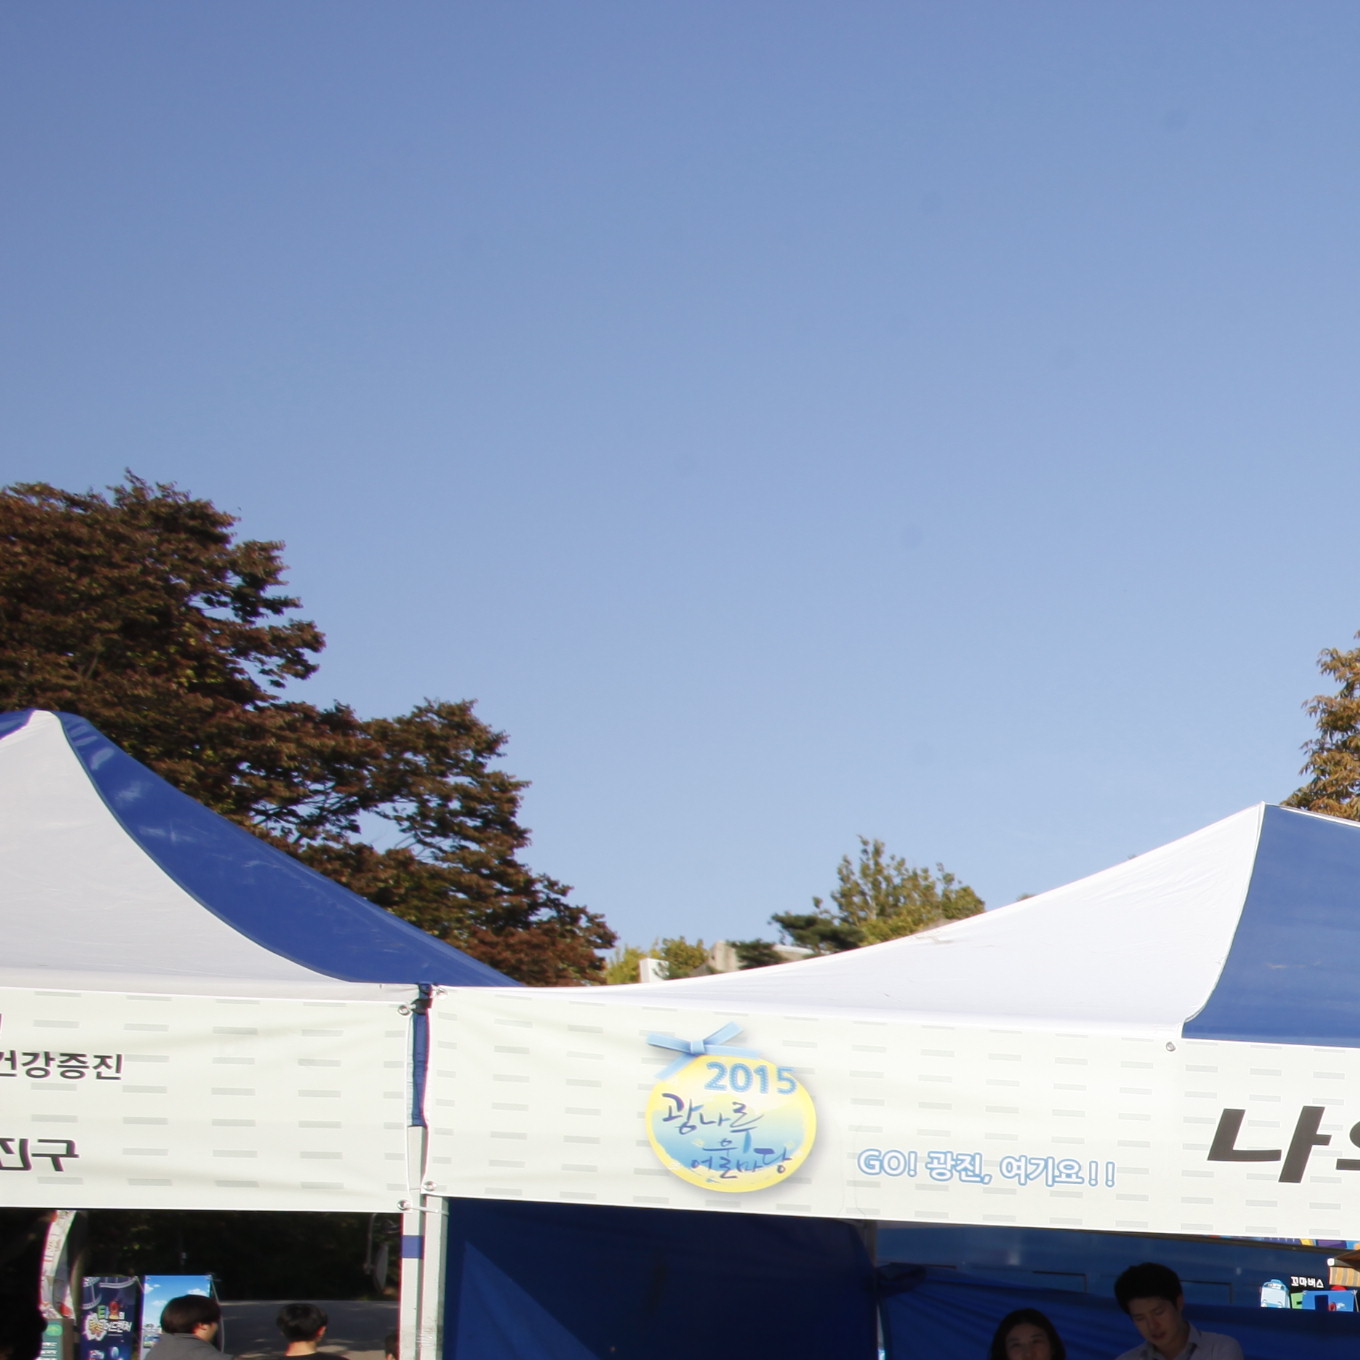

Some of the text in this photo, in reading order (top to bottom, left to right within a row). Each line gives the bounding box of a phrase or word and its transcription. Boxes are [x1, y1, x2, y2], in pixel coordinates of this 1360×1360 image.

[704, 1061, 797, 1095] 2015
[857, 1148, 918, 1177] GO!
[925, 1151, 993, 1185] 광진,
[1290, 1275, 1325, 1290] 꼬마버스
